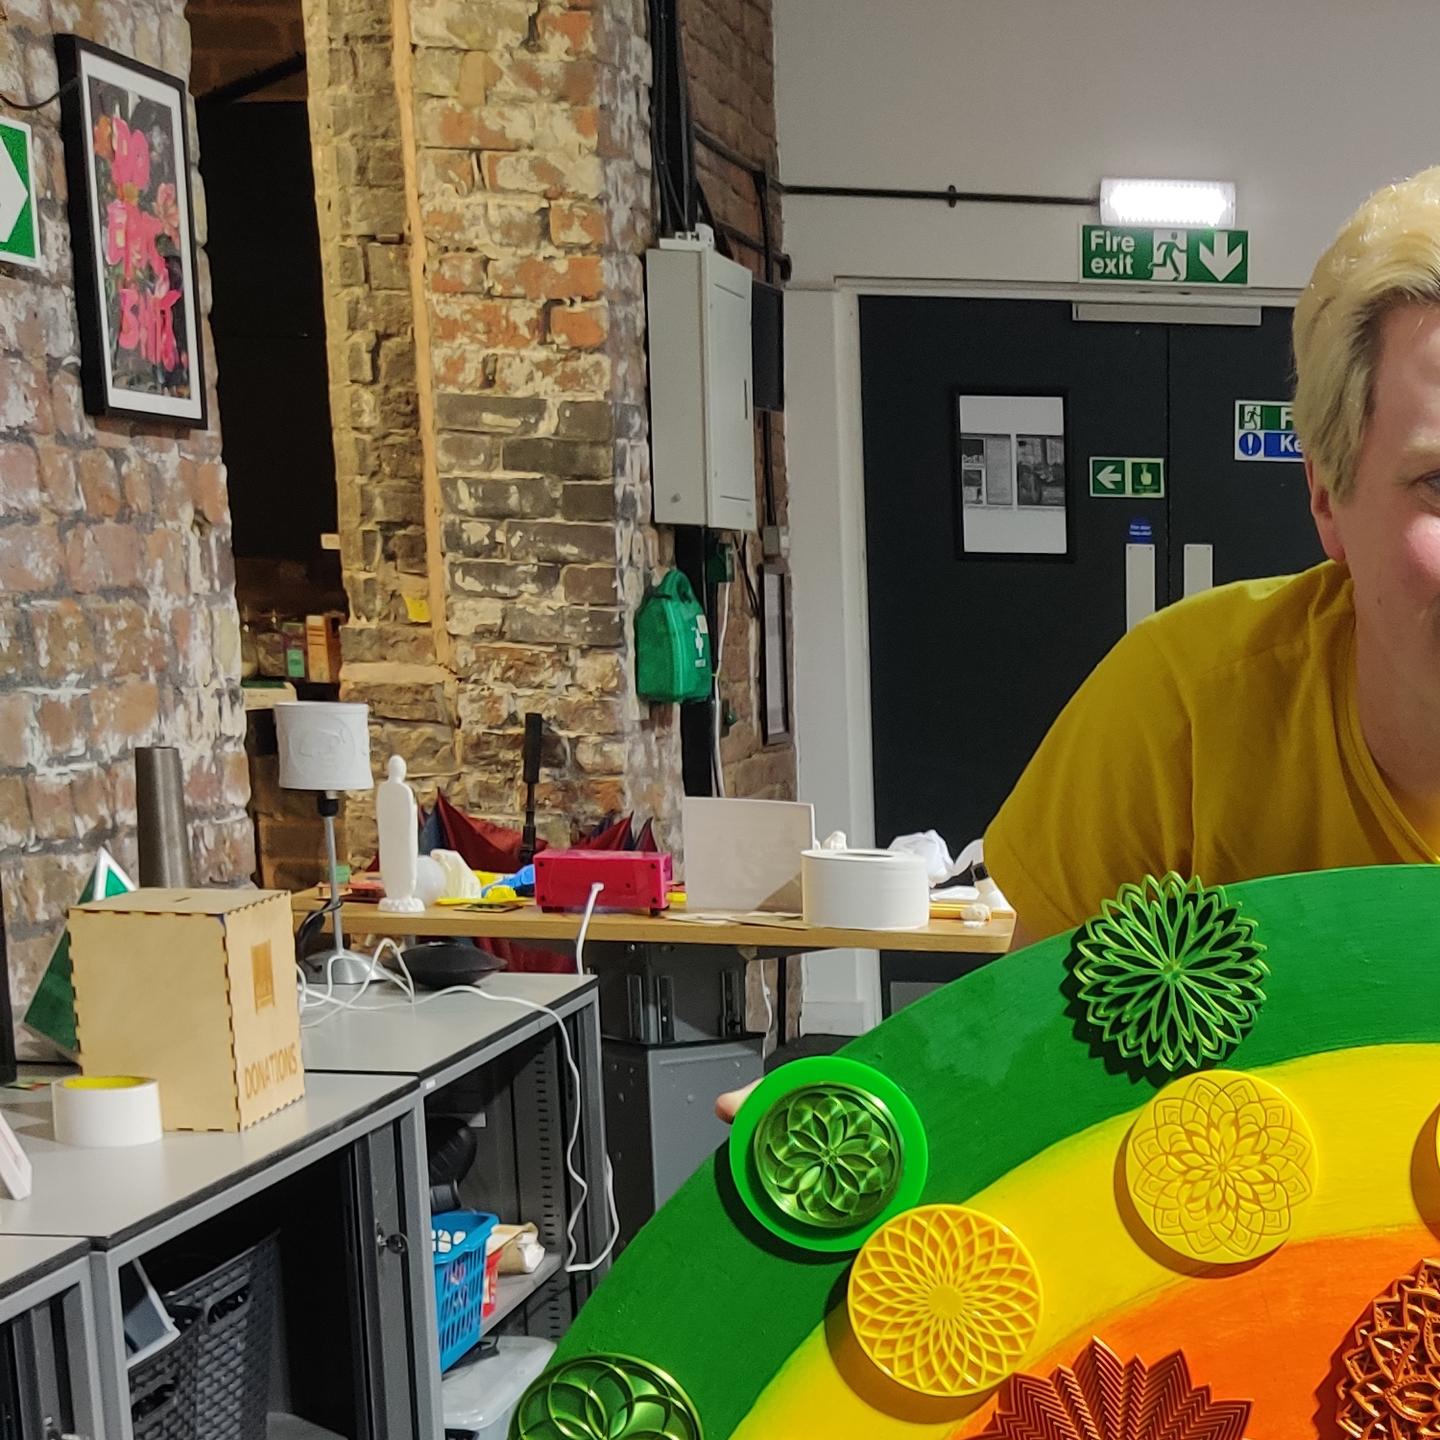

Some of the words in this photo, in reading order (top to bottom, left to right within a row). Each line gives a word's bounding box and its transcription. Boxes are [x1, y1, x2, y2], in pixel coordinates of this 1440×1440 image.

[1090, 230, 1135, 253] Fire
[1090, 253, 1134, 275] exit
[1280, 433, 1304, 454] Ke
[244, 1042, 299, 1099] DONATIONS
